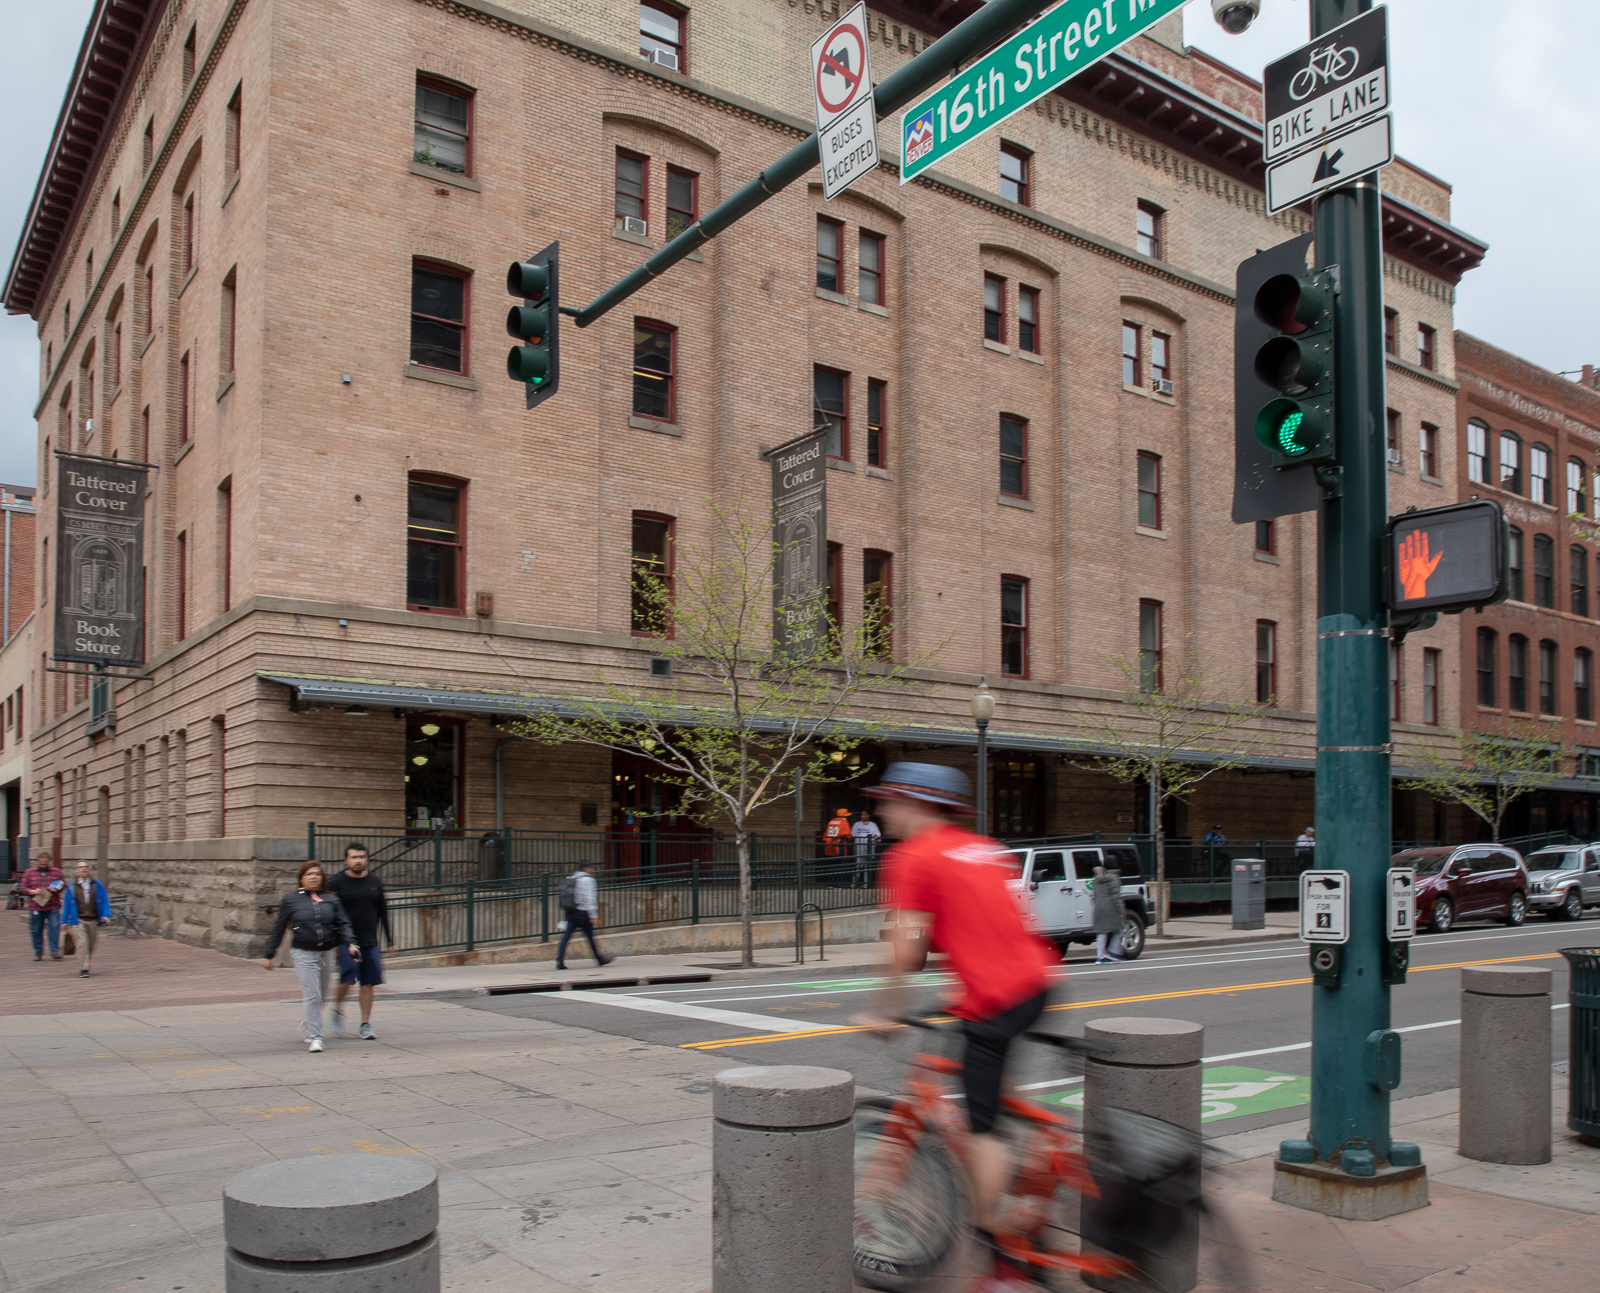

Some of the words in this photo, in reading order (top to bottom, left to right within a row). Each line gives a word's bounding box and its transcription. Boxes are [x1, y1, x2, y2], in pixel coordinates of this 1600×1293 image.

[937, 67, 1005, 143] 16th
[1014, 0, 1118, 93] Street
[1273, 107, 1314, 149] BIKE
[1330, 76, 1381, 122] LANE
[831, 117, 862, 154] BUSES
[826, 139, 874, 186] EXCEPTED
[905, 137, 933, 167] DENVER
[776, 441, 820, 472] Tattered
[66, 470, 138, 494] Tattered
[782, 467, 815, 489] Cover
[75, 491, 128, 511] Cover
[76, 619, 121, 638] Book
[75, 637, 122, 655] Store
[1316, 902, 1331, 911] FOR
